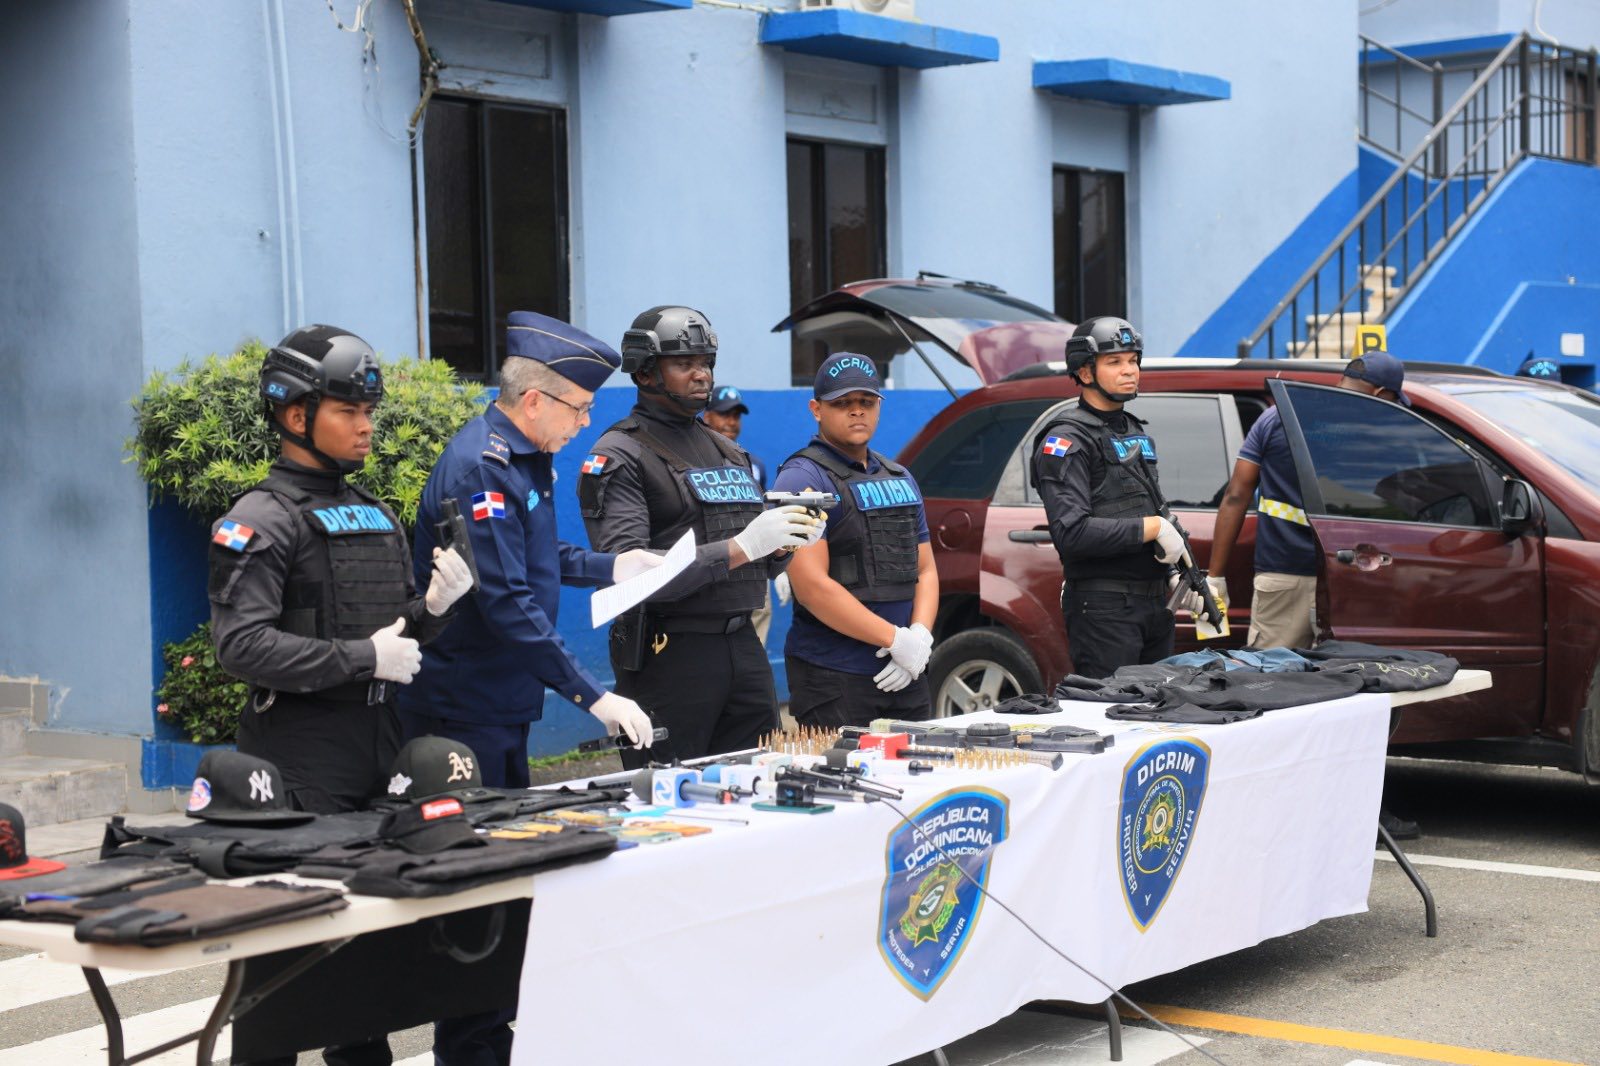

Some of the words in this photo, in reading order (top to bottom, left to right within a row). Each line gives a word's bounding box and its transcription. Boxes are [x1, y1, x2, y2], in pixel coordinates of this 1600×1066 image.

[828, 357, 874, 378] DICRIM
[690, 468, 754, 487] POLICIA
[697, 484, 762, 501] NACIONAL
[856, 479, 918, 508] POLICIA
[312, 504, 395, 532] DICRIM
[1137, 751, 1196, 787] DICRIM
[912, 806, 989, 844] REPÚBLICA
[904, 827, 993, 871] DOMINICANA
[1123, 814, 1139, 895] PROTEGER
[1144, 893, 1152, 906] Y
[1165, 809, 1195, 879] SERVIR
[923, 968, 930, 977] Y
[940, 917, 966, 960] SERVIR
